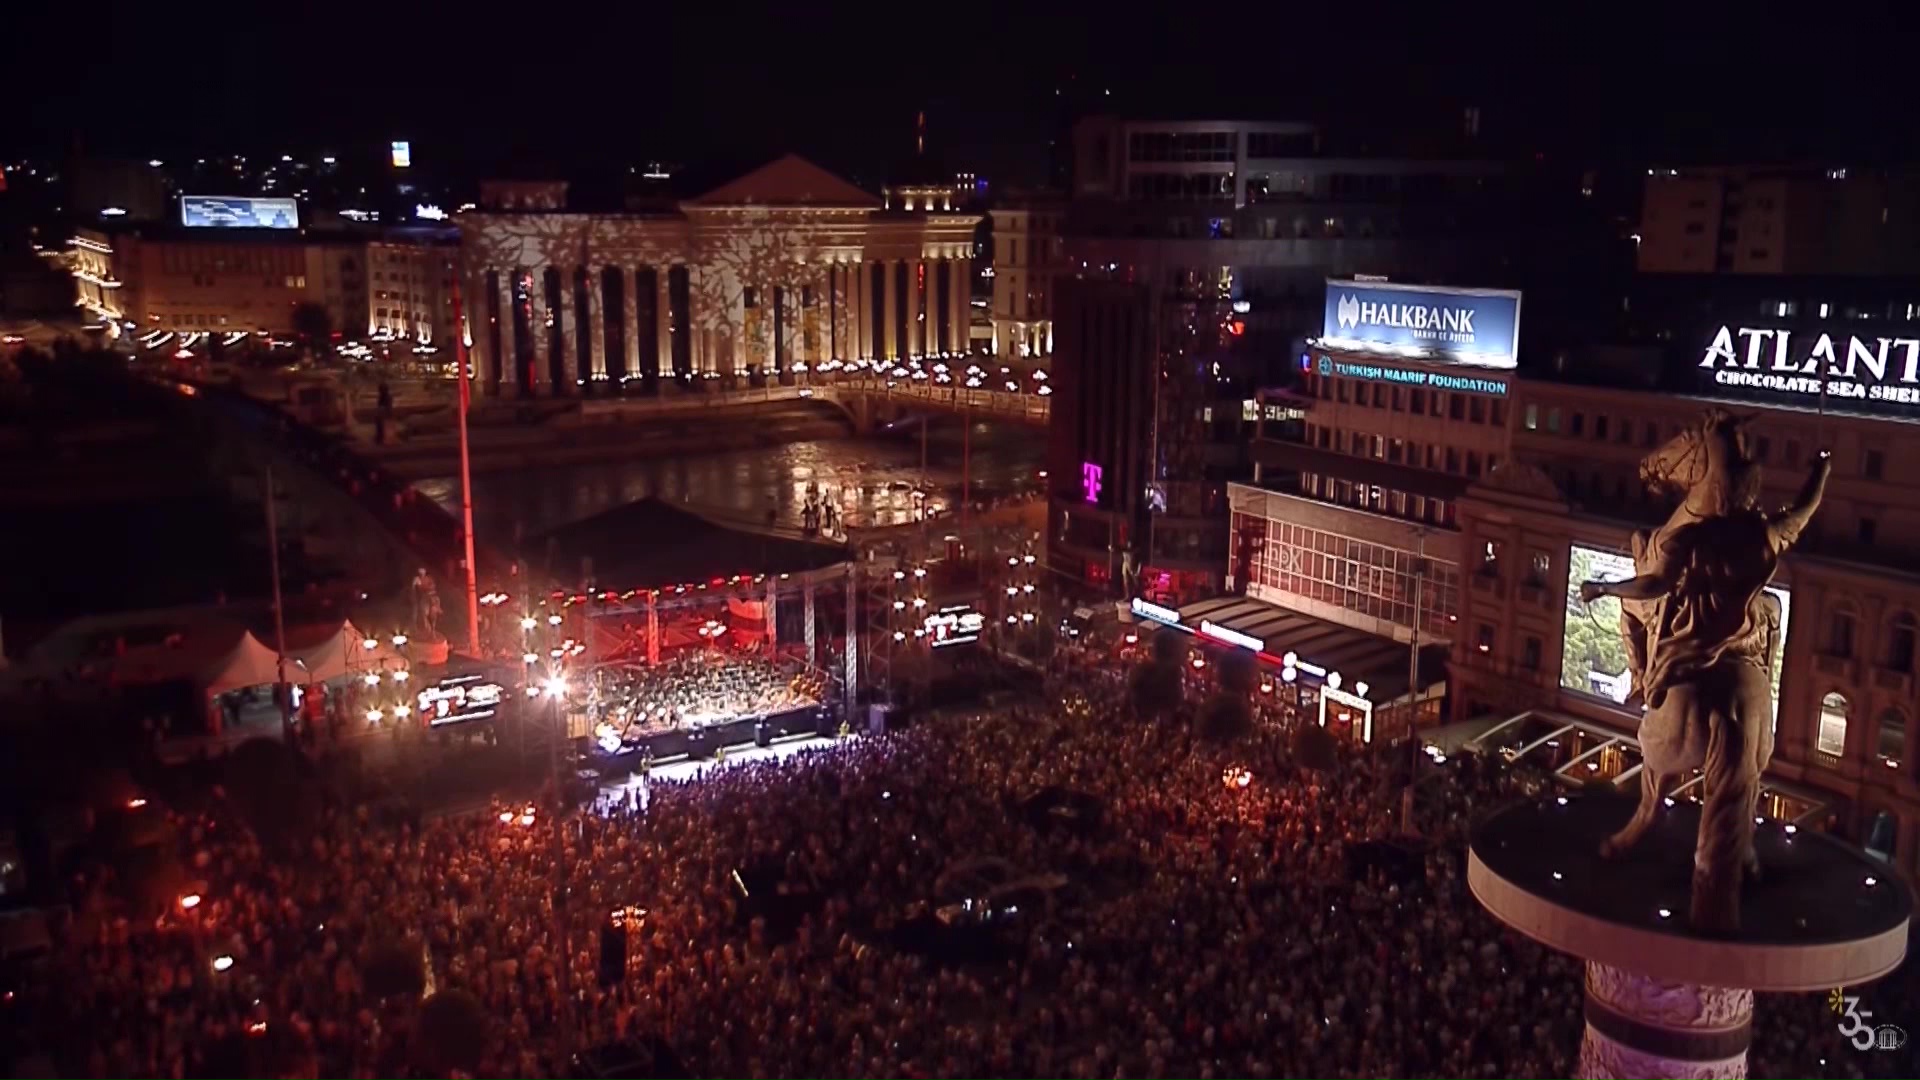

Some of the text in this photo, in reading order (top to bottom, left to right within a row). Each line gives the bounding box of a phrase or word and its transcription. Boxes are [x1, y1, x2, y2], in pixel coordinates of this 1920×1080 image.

[1361, 301, 1475, 333] HALKBANK
[1699, 325, 1920, 383] ATLANT
[1336, 364, 1506, 394] TURKISH MAARIF FOUNDATION
[1715, 369, 1822, 394] CHOCOLATE
[1826, 381, 1866, 399] SEA
[1083, 462, 1102, 502] T
